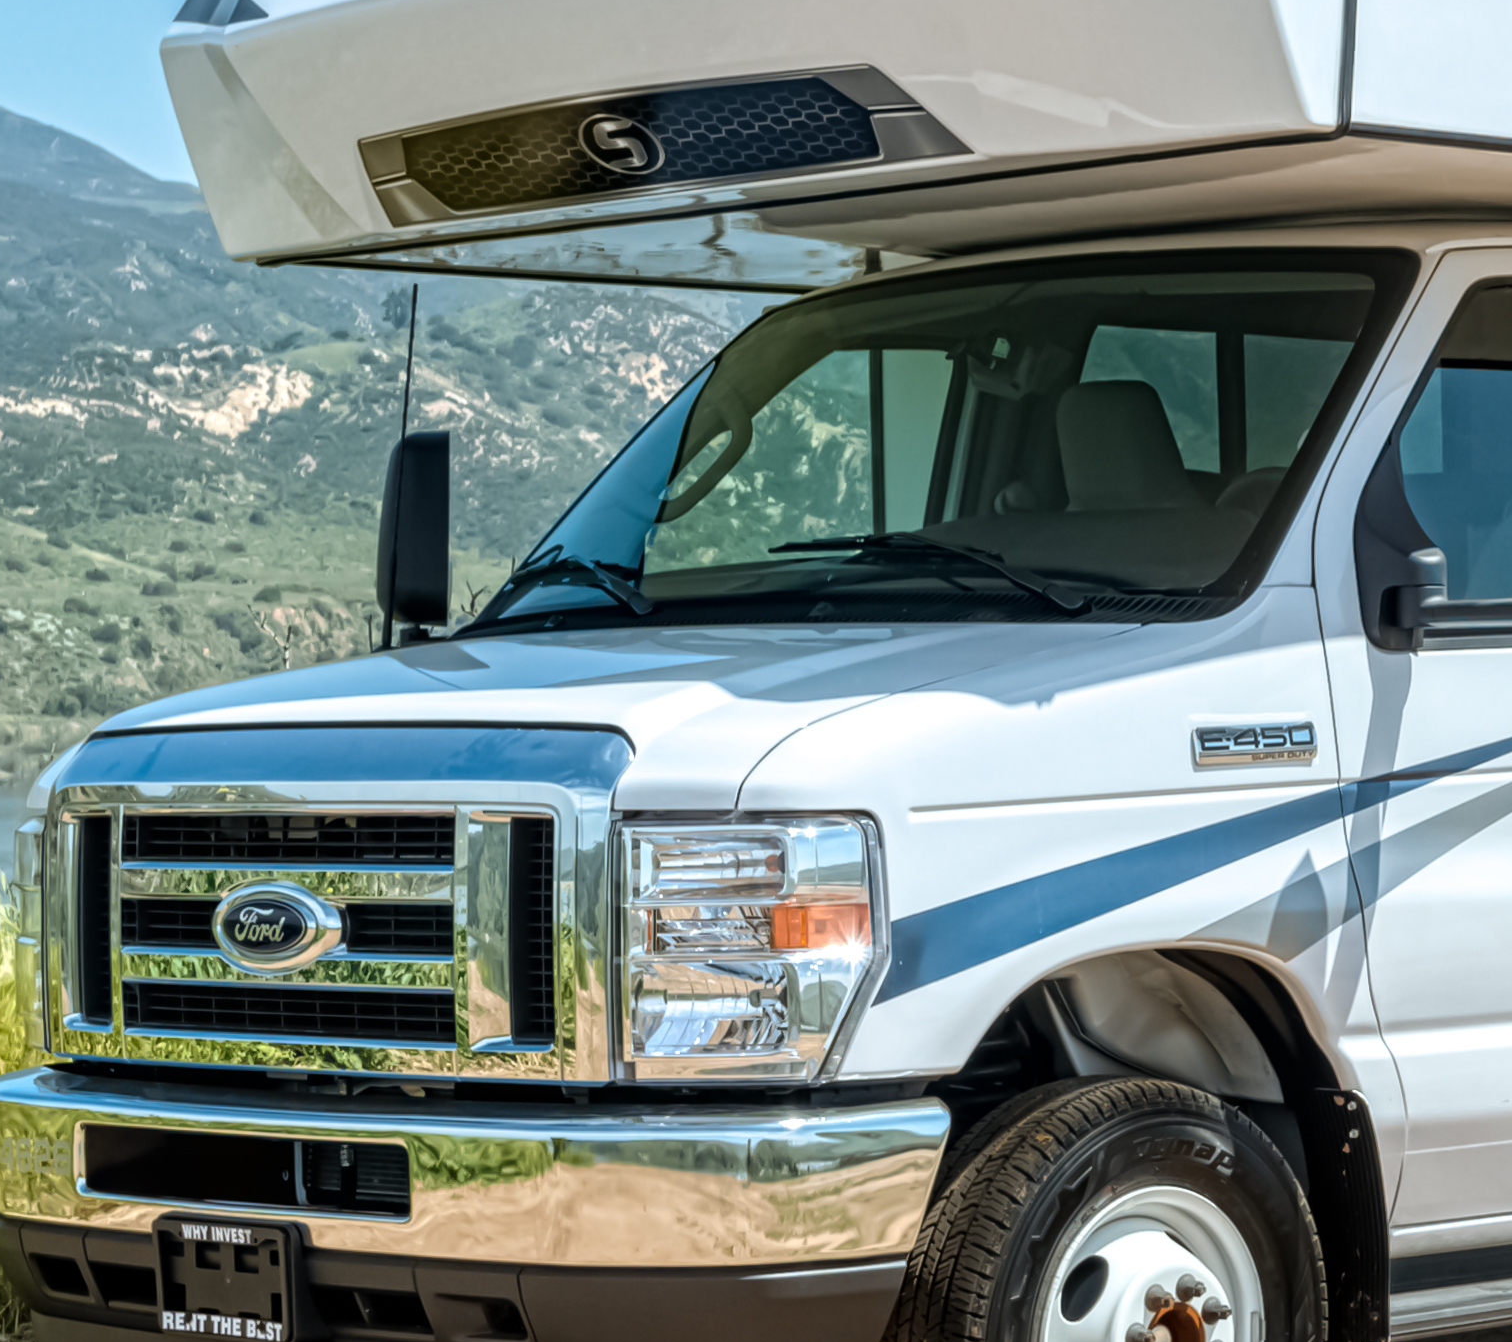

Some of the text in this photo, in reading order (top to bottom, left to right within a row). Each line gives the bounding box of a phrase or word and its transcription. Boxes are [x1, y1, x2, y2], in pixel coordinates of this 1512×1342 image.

[234, 906, 286, 943] Ford
[180, 1223, 252, 1245] WHY INVEST
[161, 1310, 208, 1333] RENT
[210, 1314, 243, 1337] THE
